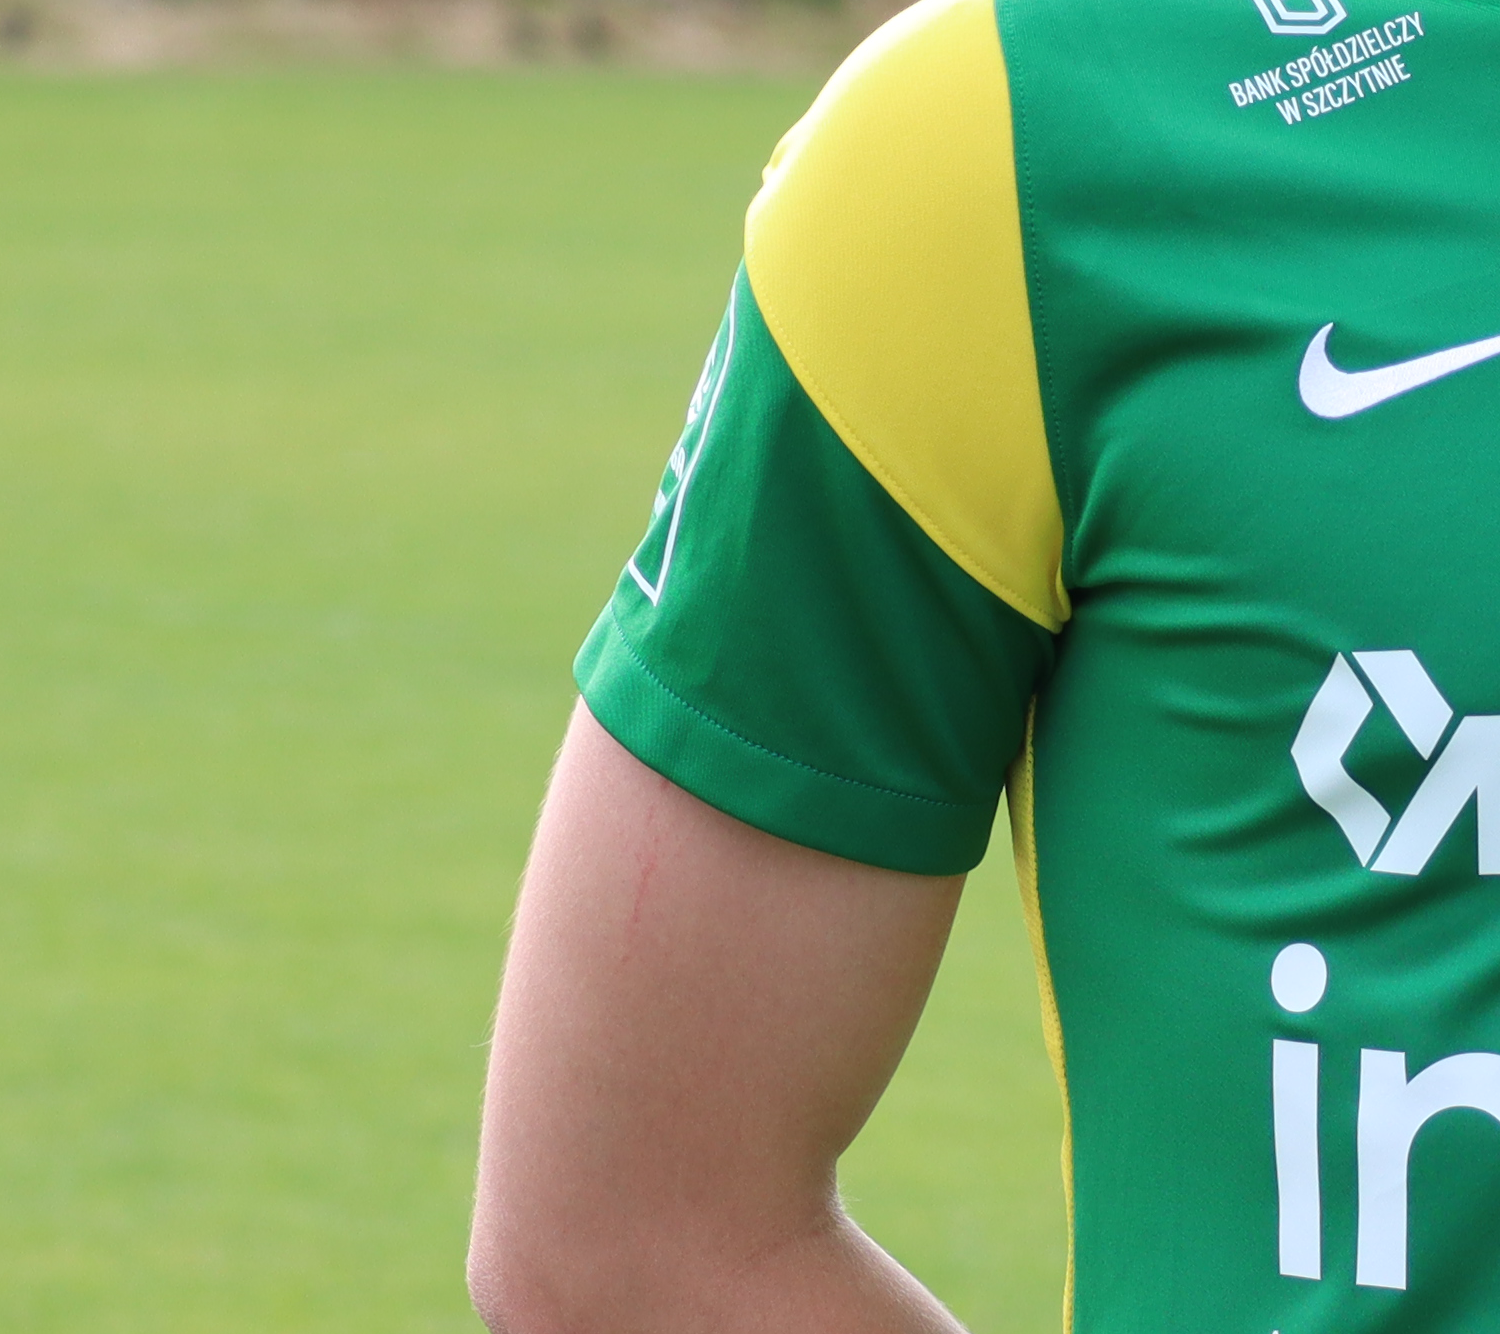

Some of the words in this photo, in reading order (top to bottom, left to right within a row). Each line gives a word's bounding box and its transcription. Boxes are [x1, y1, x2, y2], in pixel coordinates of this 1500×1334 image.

[1228, 67, 1287, 108] BANK
[1286, 11, 1425, 89] SPÓŁDZIELCZY
[1275, 95, 1302, 125] W
[1300, 54, 1412, 118] SZCZYTNIE
